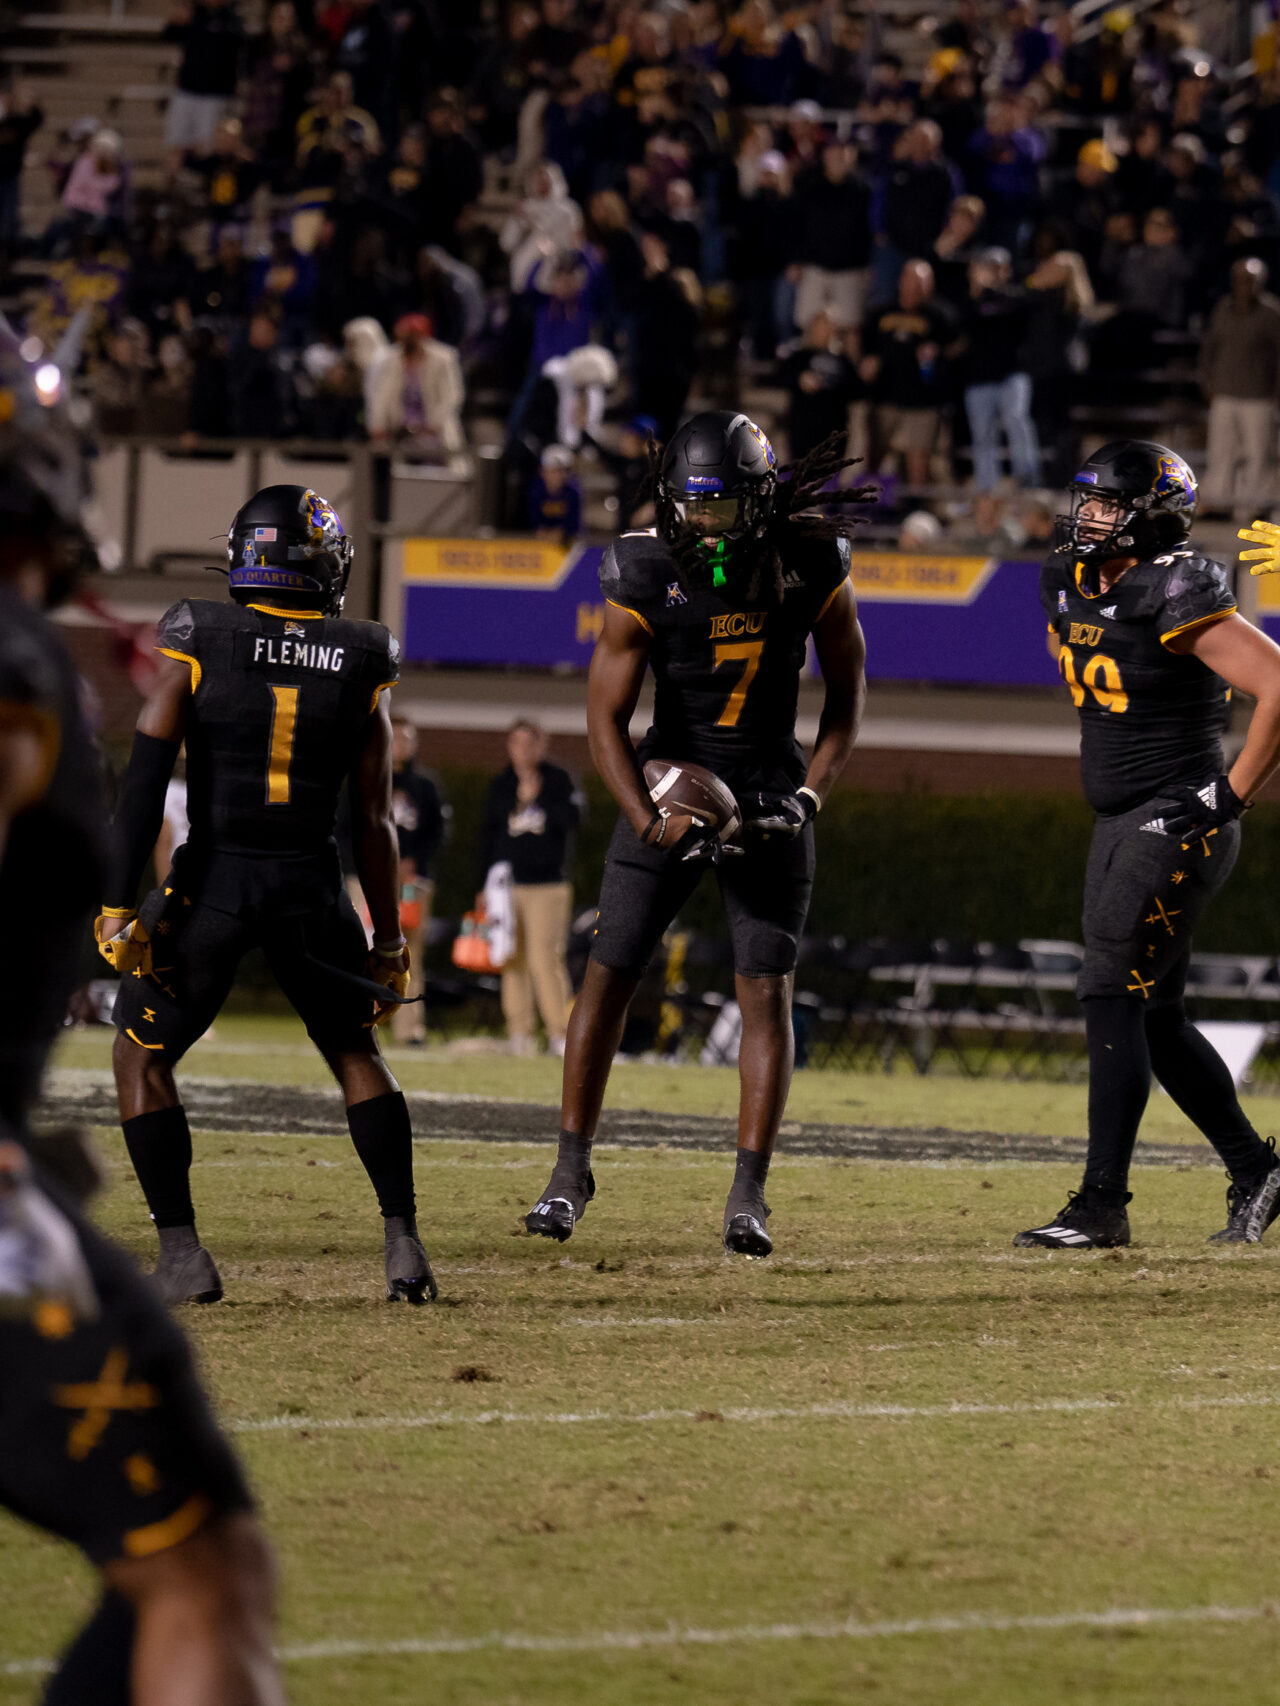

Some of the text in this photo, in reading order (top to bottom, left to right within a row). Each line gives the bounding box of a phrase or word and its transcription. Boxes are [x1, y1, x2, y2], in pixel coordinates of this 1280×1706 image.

[246, 571, 304, 586] QUARTER
[709, 612, 768, 639] ECU
[1068, 622, 1104, 646] ECU
[254, 638, 345, 671] FLEMING
[712, 640, 765, 726] 7
[265, 682, 301, 805] 1
